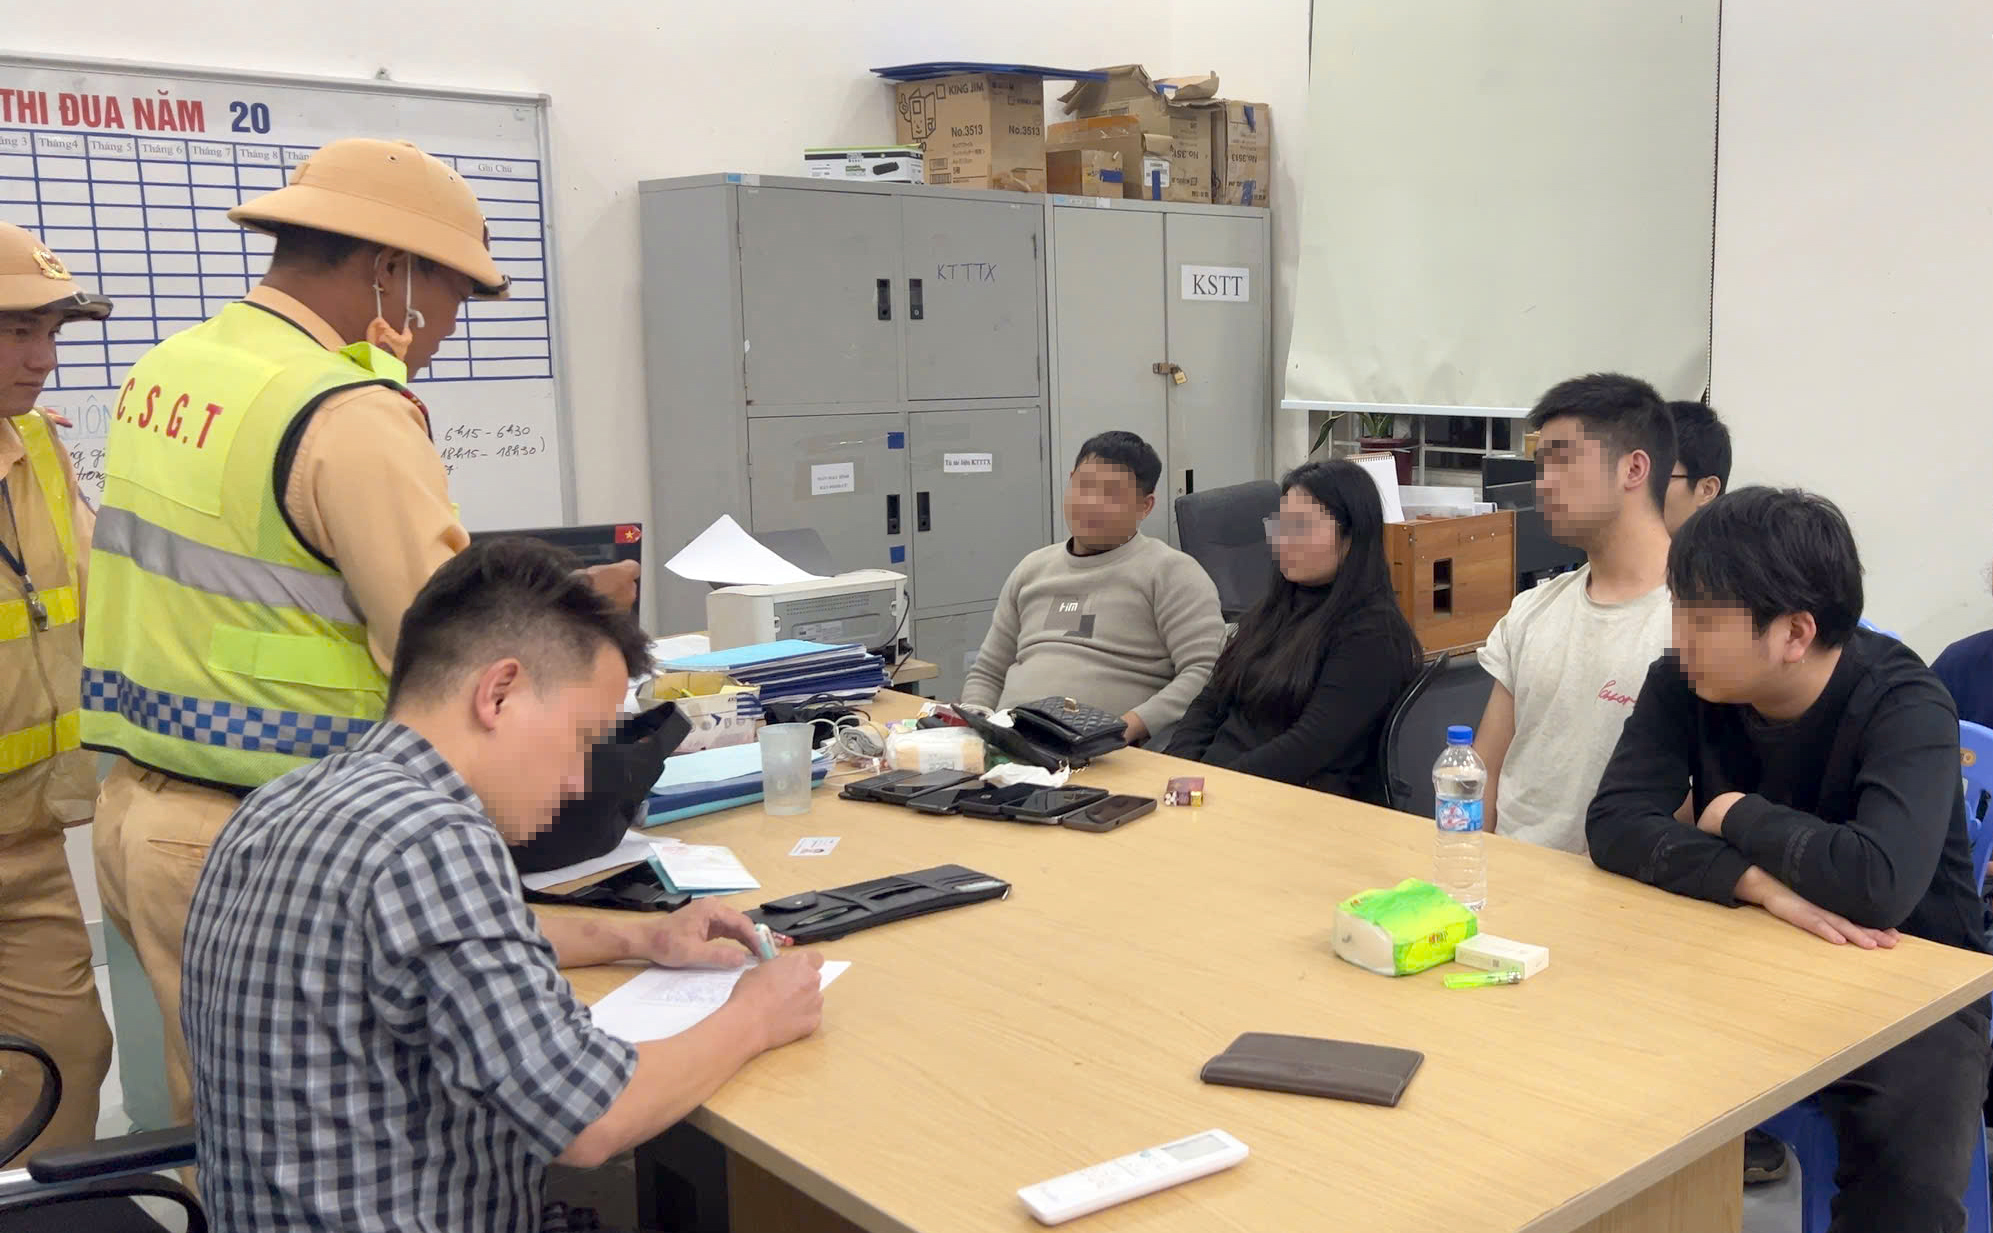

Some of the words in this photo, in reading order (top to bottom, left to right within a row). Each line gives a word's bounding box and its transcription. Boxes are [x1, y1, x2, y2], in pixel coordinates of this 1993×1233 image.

[948, 83, 969, 96] KING
[970, 82, 984, 94] JIM
[0, 87, 49, 125] THI
[58, 92, 125, 129] ĐUA
[132, 88, 206, 133] NĂM
[229, 100, 271, 134] 20
[951, 124, 983, 137] No.3513
[1008, 124, 1041, 136] No.3513
[90, 141, 125, 153] Tháng
[126, 142, 133, 152] 5
[141, 143, 174, 156] Tháng
[176, 145, 183, 155] 6
[192, 146, 223, 158] Tháng
[225, 147, 231, 157] 7
[239, 148, 269, 160] Tháng
[271, 149, 279, 160] 8
[1192, 274, 1243, 296] KSTT
[117, 377, 224, 449] C.S.G.T
[444, 425, 482, 441] 6h15
[496, 424, 531, 438] 6h30
